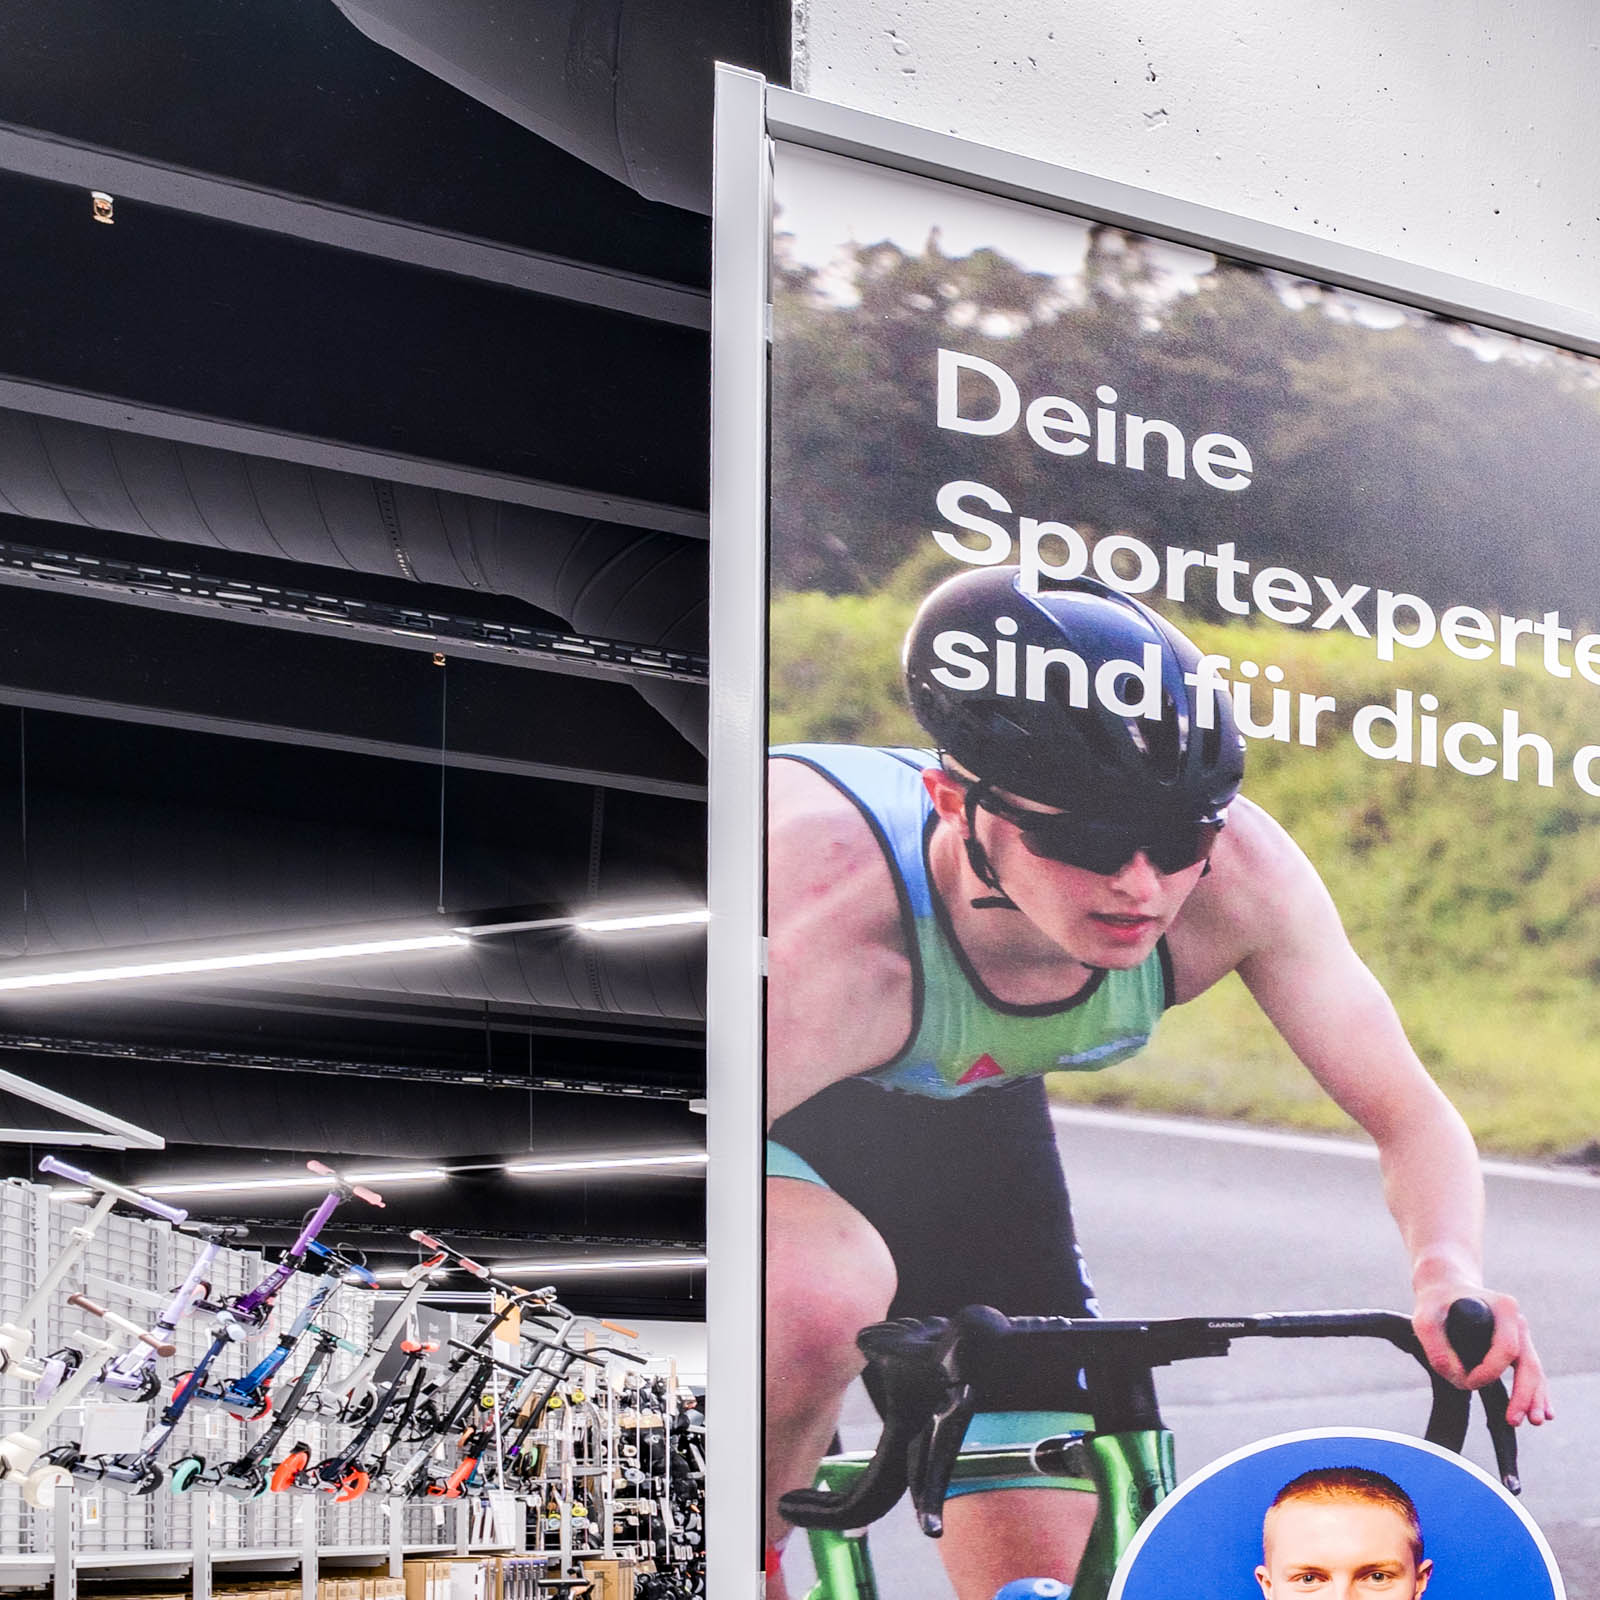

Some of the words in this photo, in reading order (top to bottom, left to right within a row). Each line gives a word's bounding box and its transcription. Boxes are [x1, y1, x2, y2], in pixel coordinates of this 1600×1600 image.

[937, 348, 1253, 491] Deine
[931, 617, 1163, 721] sind
[1185, 655, 1336, 748] für
[1353, 688, 1555, 788] dich
